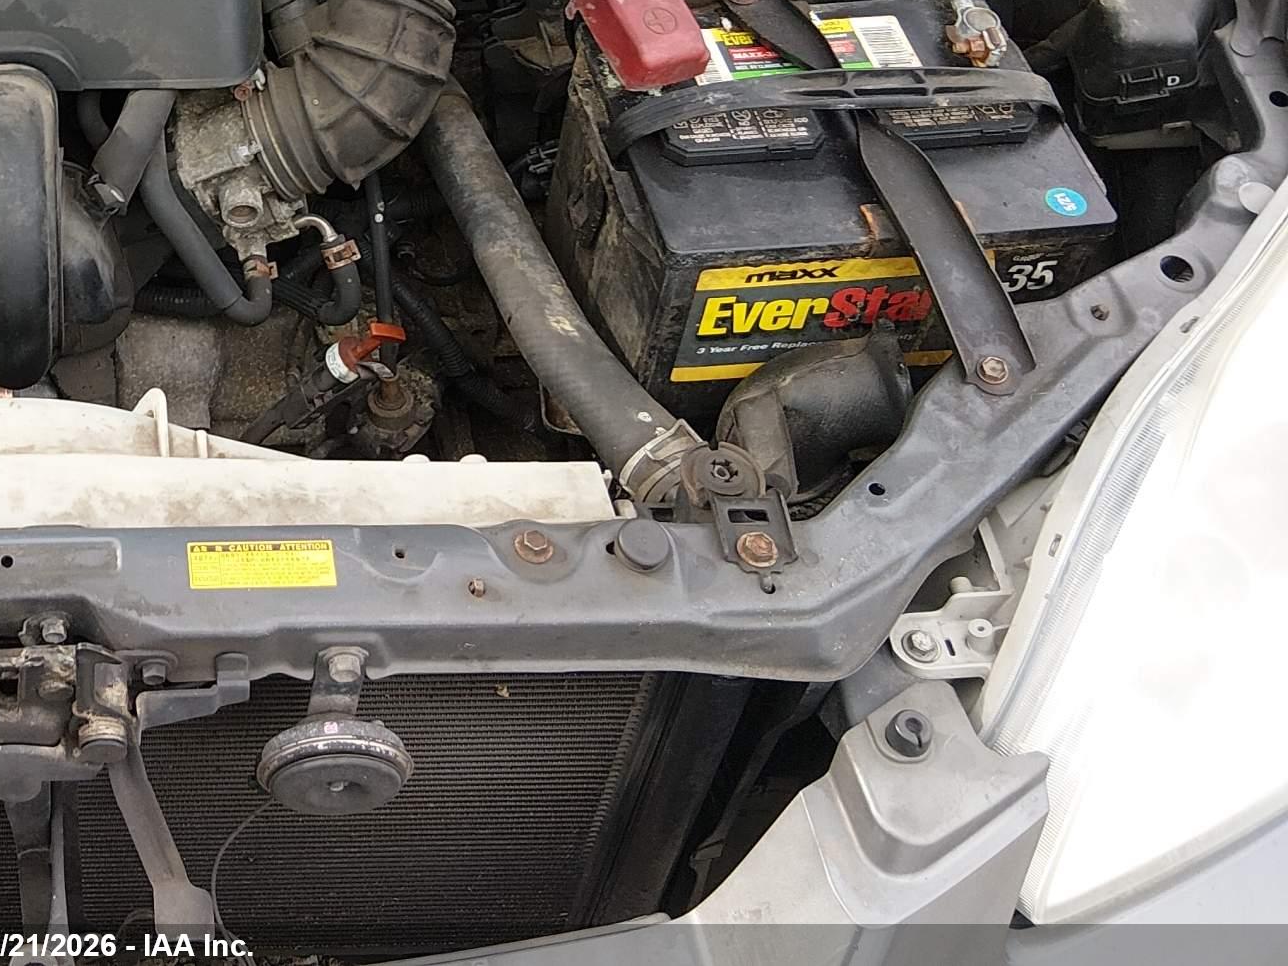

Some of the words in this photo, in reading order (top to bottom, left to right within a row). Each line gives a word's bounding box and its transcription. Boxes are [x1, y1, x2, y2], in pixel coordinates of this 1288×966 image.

[1167, 75, 1181, 87] D
[744, 266, 840, 284] maxx
[1004, 260, 1059, 292] 35
[696, 347, 707, 355] 3
[710, 345, 736, 355] Year
[740, 343, 769, 353] Free
[228, 543, 273, 552] CAUTION
[278, 542, 328, 551] ATTENTION
